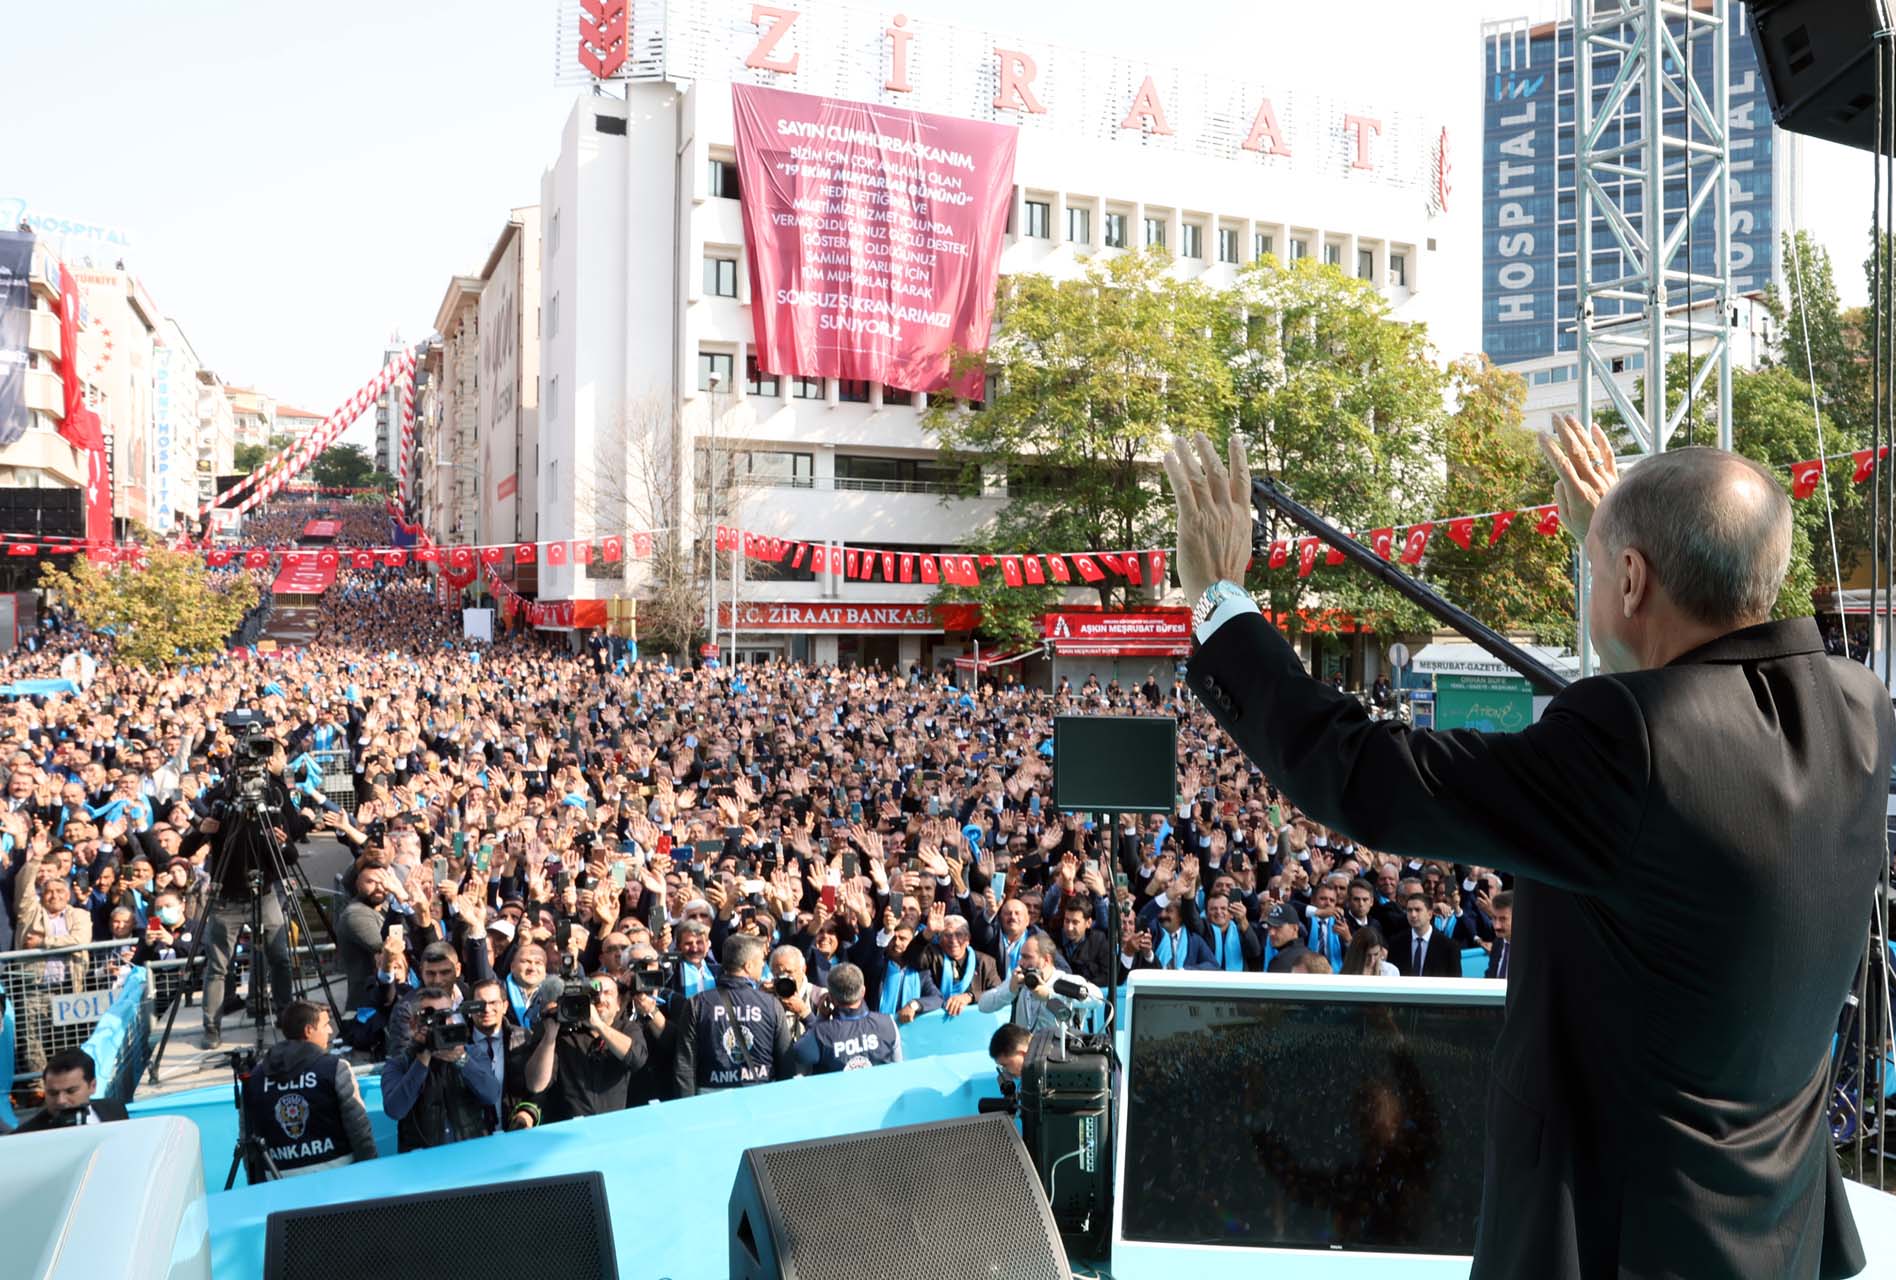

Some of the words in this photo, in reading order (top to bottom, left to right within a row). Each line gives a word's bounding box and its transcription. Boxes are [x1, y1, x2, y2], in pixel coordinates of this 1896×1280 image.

[744, 3, 1382, 172] ZİRAAT
[777, 119, 824, 138] SAYIN
[827, 125, 975, 172] CUMHURBAŞKANIM,
[790, 145, 822, 161] BİZİM
[825, 149, 849, 165] İÇİN
[851, 154, 876, 169] ÇOK
[928, 171, 962, 188] OLAN
[801, 163, 832, 180] EKİM
[834, 170, 907, 193] MUHTARLAR
[820, 184, 860, 201] HEDİYE
[913, 201, 928, 215] VE
[1498, 101, 1536, 322] HOSPITAL
[815, 218, 887, 239] OLDUĞUNUZ
[889, 228, 925, 248] GÜÇLÜ
[857, 205, 898, 224] HİZMET
[899, 215, 954, 237] YOLUNDA
[806, 250, 850, 266] SAMİMİ
[904, 264, 930, 282] İÇİN
[864, 242, 937, 267] OLDUĞUNUZ
[802, 264, 824, 281] TÜM
[891, 281, 933, 300] OLARAK
[777, 289, 838, 308] SONSUZ
[840, 293, 952, 329] ŞÜKRANARIMIZI
[768, 604, 842, 624] ZİRAAT
[846, 607, 933, 624] BANKASI
[1081, 624, 1108, 634] AŞKIN
[1109, 624, 1154, 634] MEŞRUBAT
[1155, 623, 1186, 633] BÜFESİ
[834, 1034, 879, 1058] POLİS
[270, 1138, 335, 1162] ANKARA
